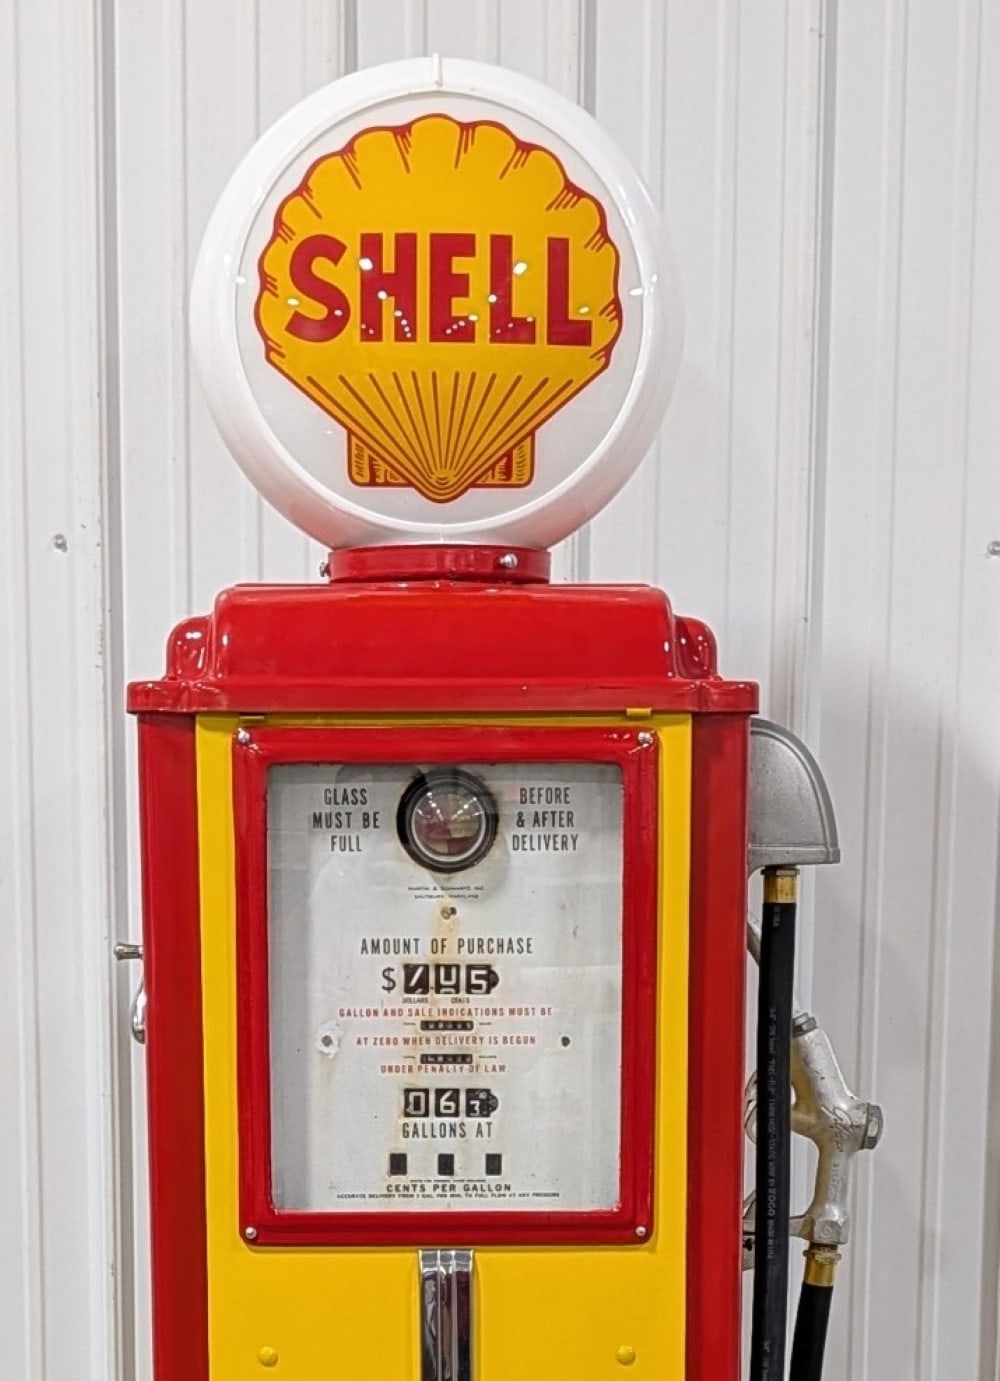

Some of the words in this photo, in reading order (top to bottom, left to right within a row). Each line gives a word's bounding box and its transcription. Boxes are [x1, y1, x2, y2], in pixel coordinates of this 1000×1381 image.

[285, 233, 593, 347] SHELL
[324, 788, 368, 805] GLASS
[519, 787, 571, 804] BEFORE
[312, 811, 355, 829] MUST
[362, 811, 381, 829] BE
[516, 812, 526, 828] &
[532, 811, 575, 828] AFTER
[330, 835, 363, 852] FULL
[512, 834, 579, 852] DELIVERY
[361, 937, 420, 956] AMOUNT
[430, 937, 447, 955] OF
[457, 937, 533, 955] PURCHASE
[338, 1008, 379, 1018] GALLON
[383, 1008, 404, 1017] AND
[407, 1008, 433, 1017] SALE
[437, 1007, 504, 1017] INDICATIONS
[508, 1007, 536, 1016] MUST
[540, 1007, 553, 1016] BE
[355, 1036, 369, 1046] AT
[372, 1036, 399, 1046] ZERO
[402, 1036, 431, 1046] WHEN
[435, 1036, 485, 1046] DELIVERY
[488, 1035, 499, 1046] IS
[502, 1035, 536, 1045] BEGUN
[380, 1064, 414, 1074] UNDER
[417, 1064, 465, 1074] PENALTY
[468, 1064, 480, 1073] OF
[402, 1121, 467, 1139] GALLONS
[475, 1121, 493, 1139] AT
[386, 1183, 427, 1193] CENTS
[432, 1183, 457, 1193] PER
[463, 1183, 512, 1193] GALLON
